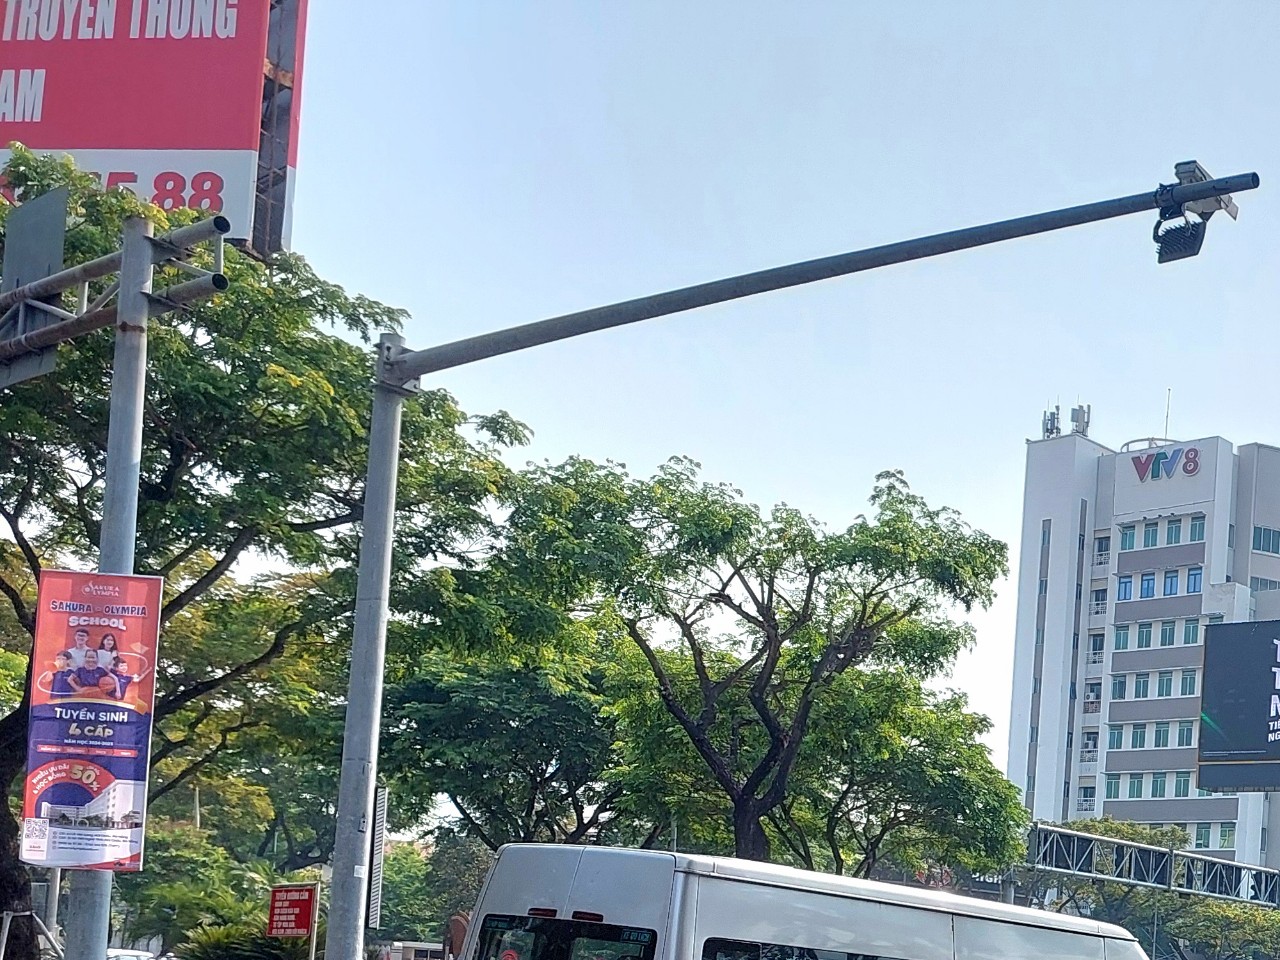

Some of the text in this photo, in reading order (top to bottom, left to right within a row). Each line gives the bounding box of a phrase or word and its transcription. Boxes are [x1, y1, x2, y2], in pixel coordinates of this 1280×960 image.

[1131, 447, 1200, 483] VTV8
[50, 600, 92, 613] SAKURA
[104, 605, 148, 617] OLYMPIA
[69, 616, 126, 630] SCHOOL
[98, 711, 128, 722] SINH
